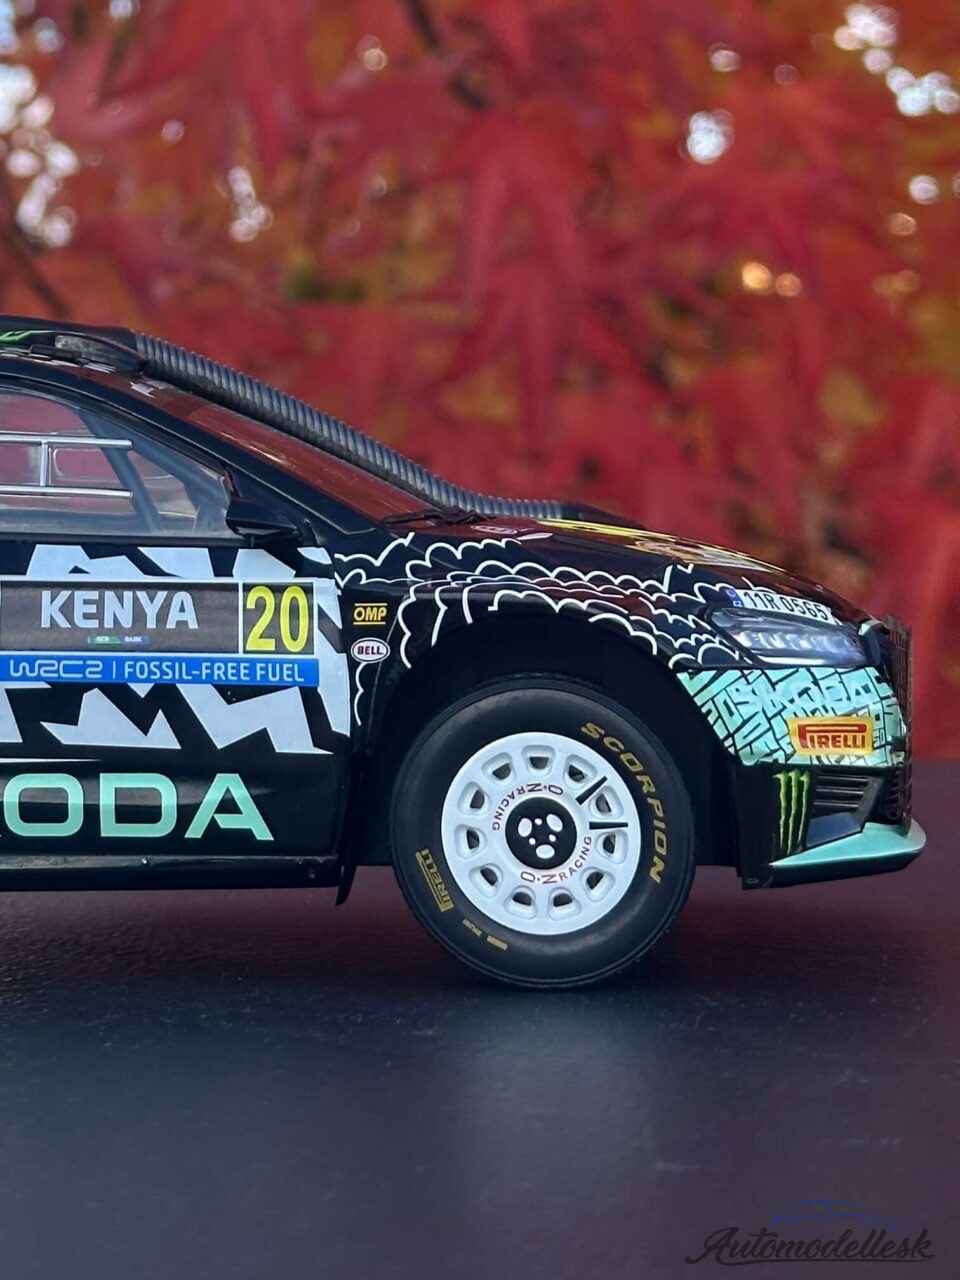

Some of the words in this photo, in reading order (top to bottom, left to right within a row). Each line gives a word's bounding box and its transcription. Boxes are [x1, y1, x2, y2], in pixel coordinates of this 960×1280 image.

[40, 590, 199, 629] KENYA
[245, 585, 309, 652] 20
[353, 606, 388, 621] OMP
[357, 645, 384, 655] BELL
[10, 659, 103, 678] WRC2
[124, 660, 250, 680] FOSSIL-FREE
[256, 662, 305, 682] FUEL
[797, 723, 867, 749] PIRELLI
[581, 722, 667, 883] SCORPION
[416, 848, 454, 912] PIRELLI
